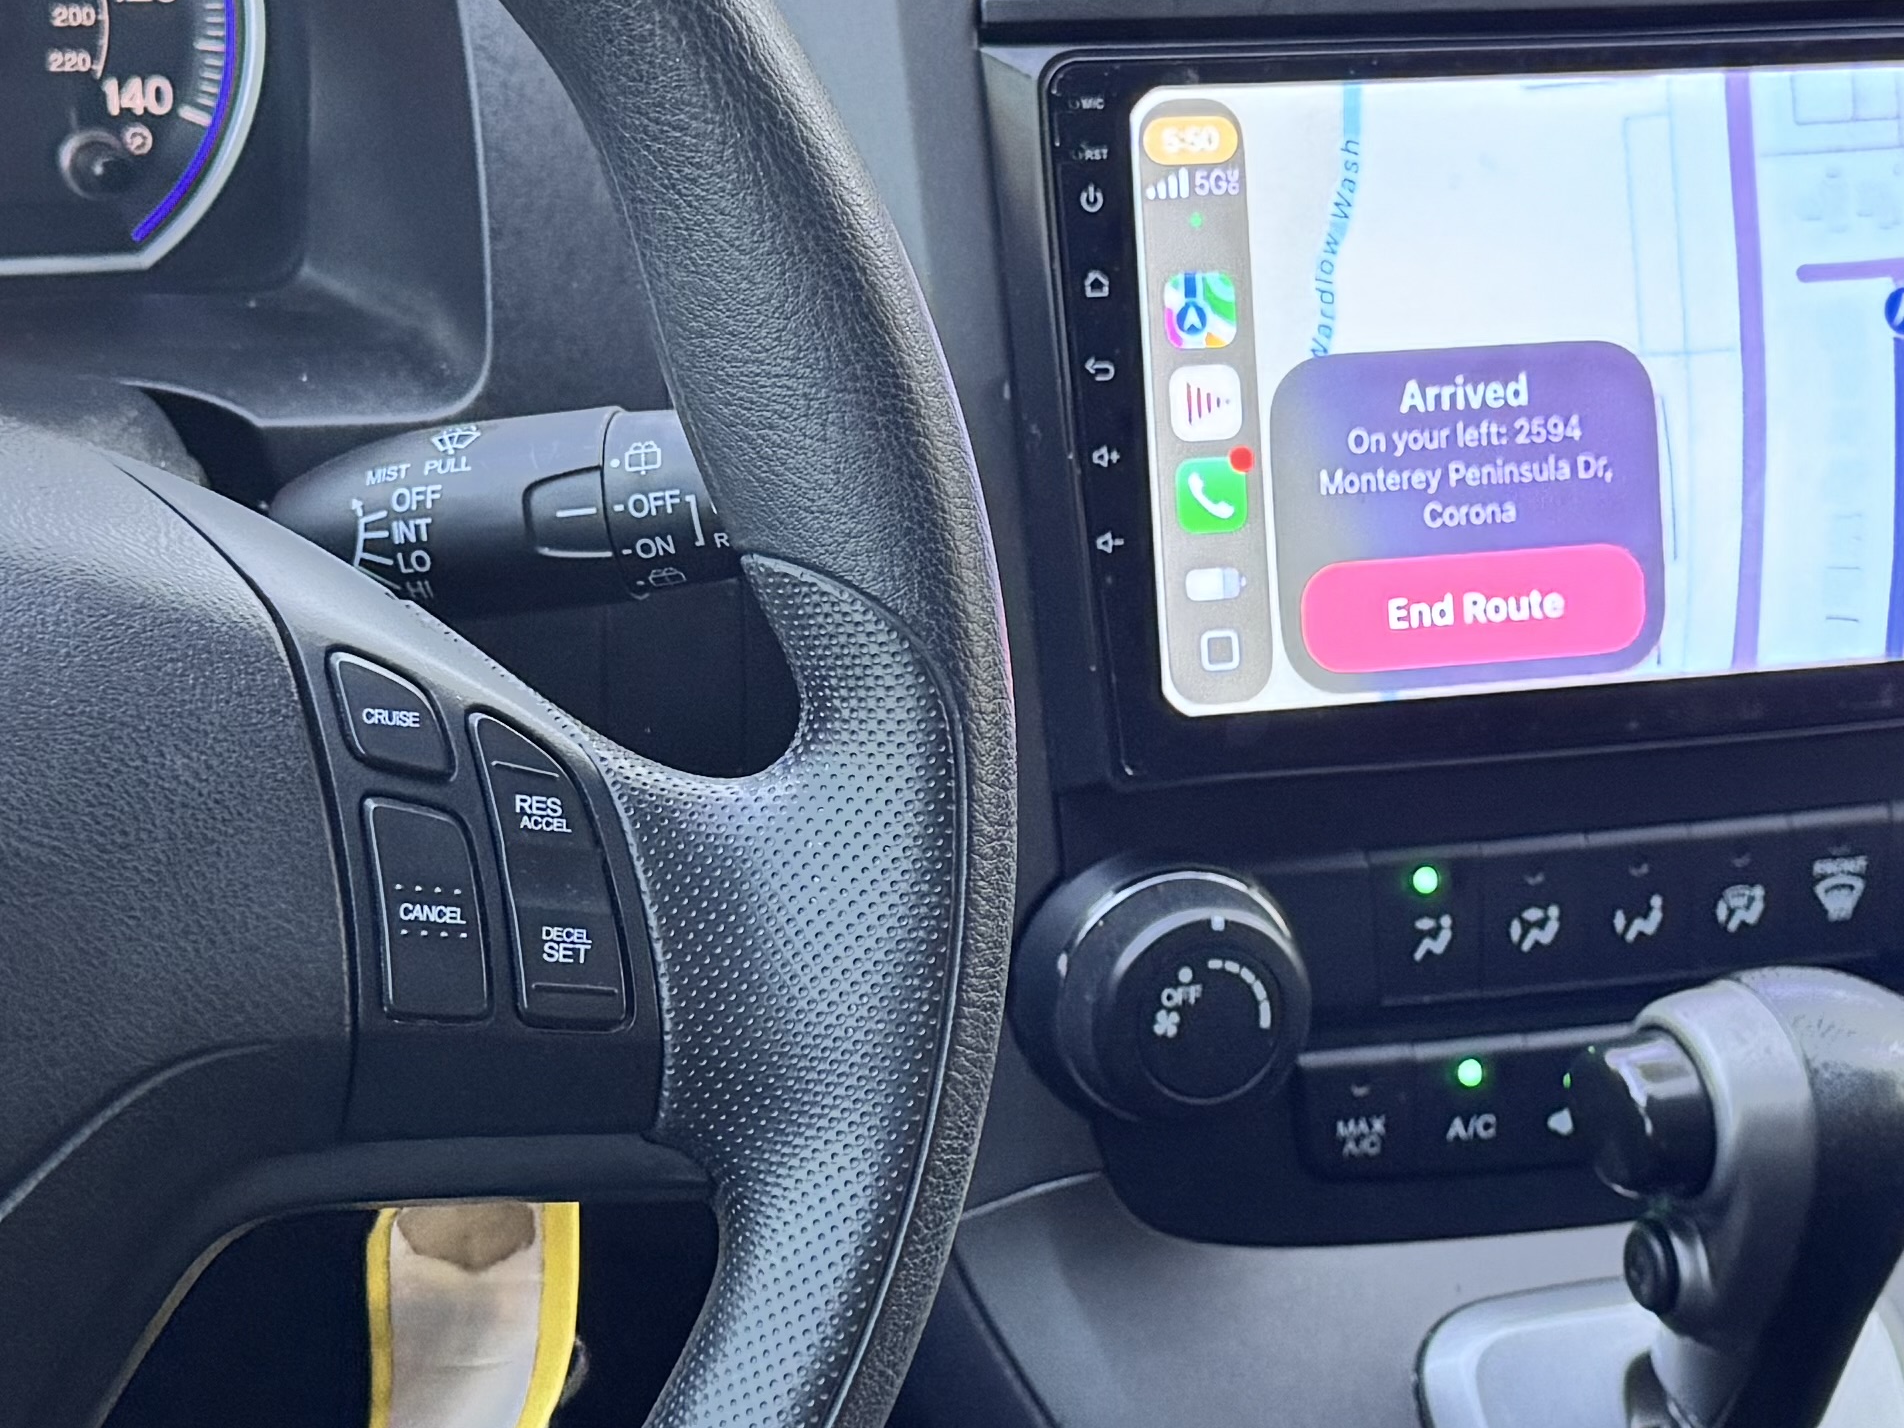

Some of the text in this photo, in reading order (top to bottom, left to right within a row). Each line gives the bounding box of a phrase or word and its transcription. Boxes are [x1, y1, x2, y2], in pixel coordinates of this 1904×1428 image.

[51, 3, 96, 28] 200
[48, 49, 92, 72] 220
[102, 75, 173, 117] 140
[1084, 148, 1108, 160] RST
[1330, 139, 1360, 220] Wash
[1399, 370, 1529, 414] Arrived
[1347, 414, 1583, 457] On your left: 2594
[366, 457, 472, 486] MIST PULL
[1319, 466, 1442, 496] Monterey
[1448, 454, 1571, 488] Peninsula
[391, 484, 443, 513] OFF
[628, 489, 681, 519] OFF
[1422, 499, 1517, 529] Corona
[392, 517, 433, 544] INT
[635, 535, 676, 560] ON
[397, 548, 431, 573] LO
[1387, 588, 1566, 630] End Route
[362, 707, 420, 728] CRUISE
[515, 793, 563, 817] RES
[519, 815, 572, 833] ACCEL
[399, 902, 467, 925] CANCEL
[541, 926, 593, 944] DECEL
[542, 942, 592, 964] SET
[1161, 983, 1203, 1008] OFF
[1336, 1114, 1386, 1140] MAX
[1446, 1113, 1497, 1142] A/C
[1343, 1135, 1382, 1157] A/C
